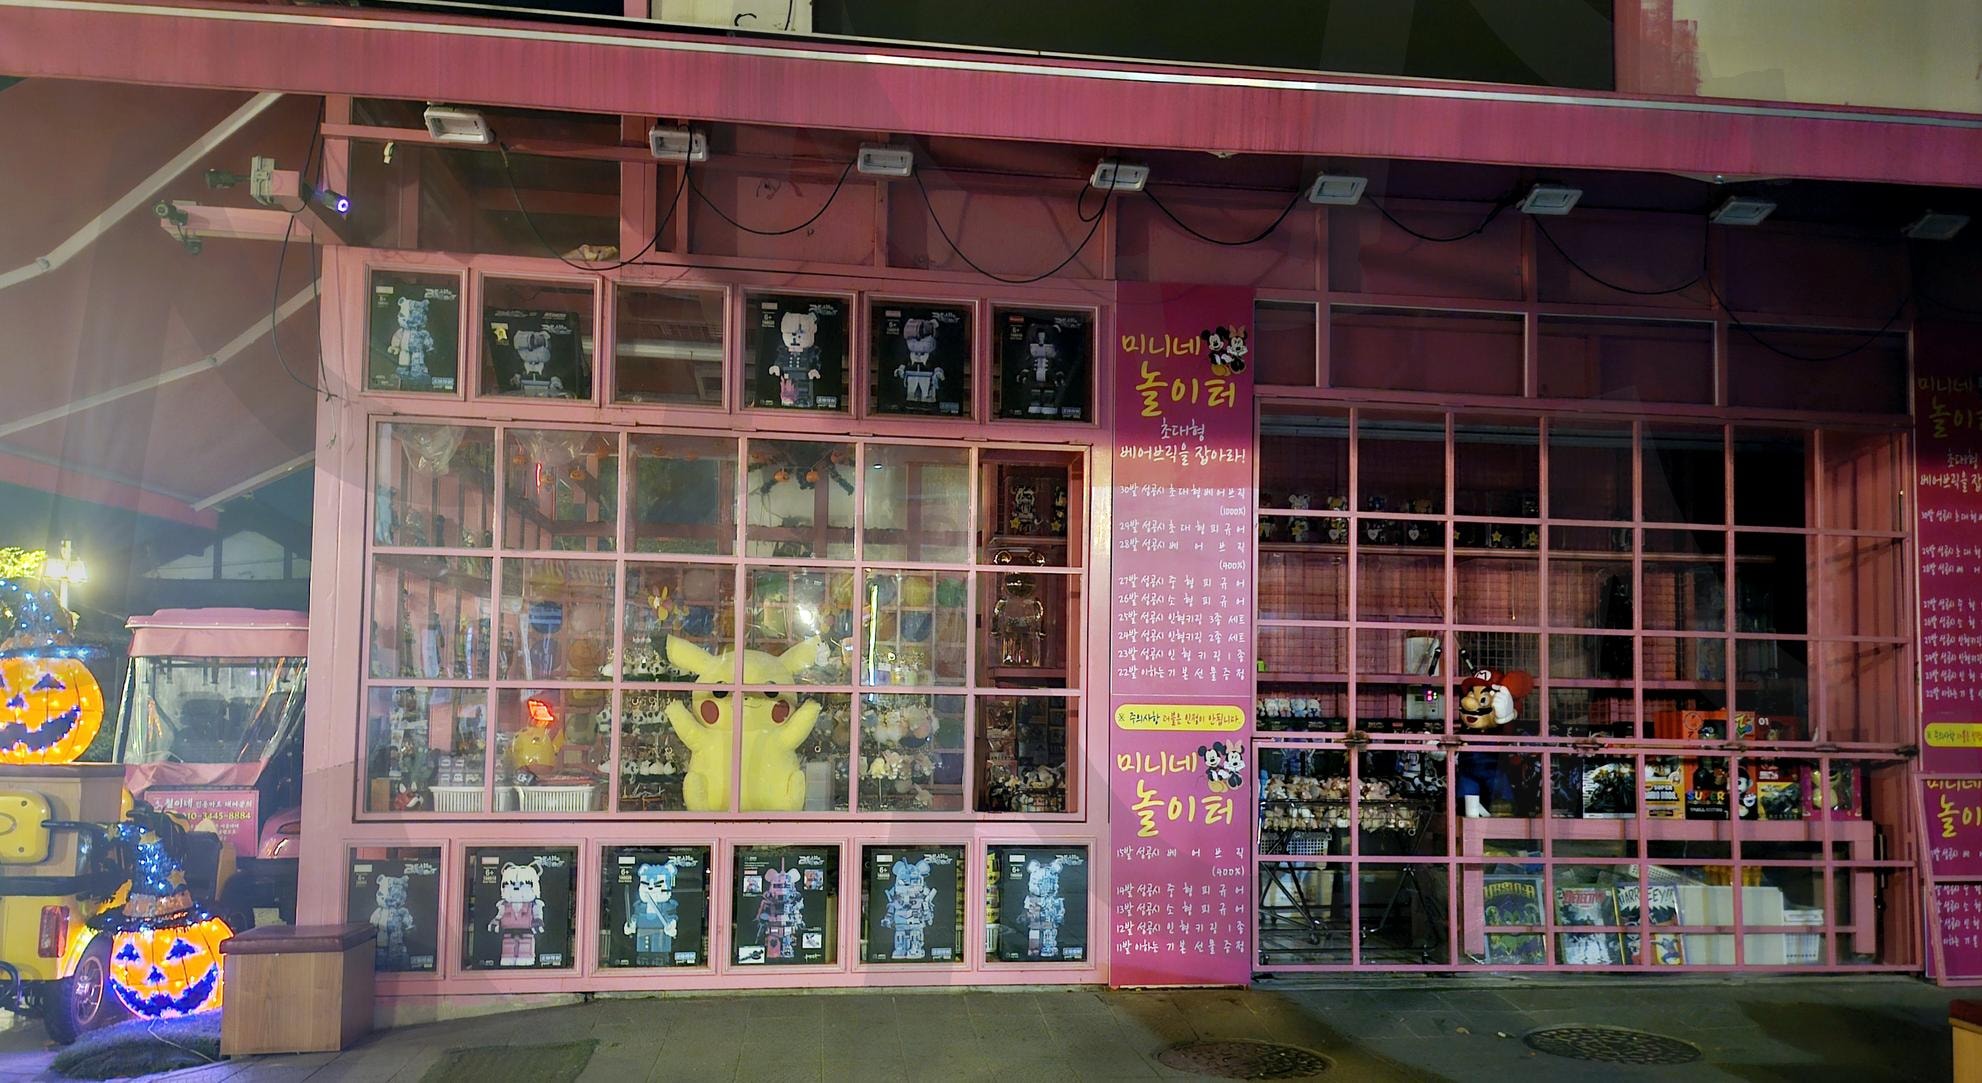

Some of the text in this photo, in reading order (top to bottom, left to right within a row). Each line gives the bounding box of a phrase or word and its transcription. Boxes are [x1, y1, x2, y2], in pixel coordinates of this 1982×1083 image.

[1122, 334, 1200, 358] 미니네
[1136, 360, 1236, 417] 놀이터
[1161, 417, 1205, 441] 초대형
[1120, 442, 1246, 466] 베어브릭을 잡아라!
[1129, 710, 1160, 725] 주의사항
[1117, 751, 1198, 776] 미니네
[1131, 779, 1233, 837] 놀이터
